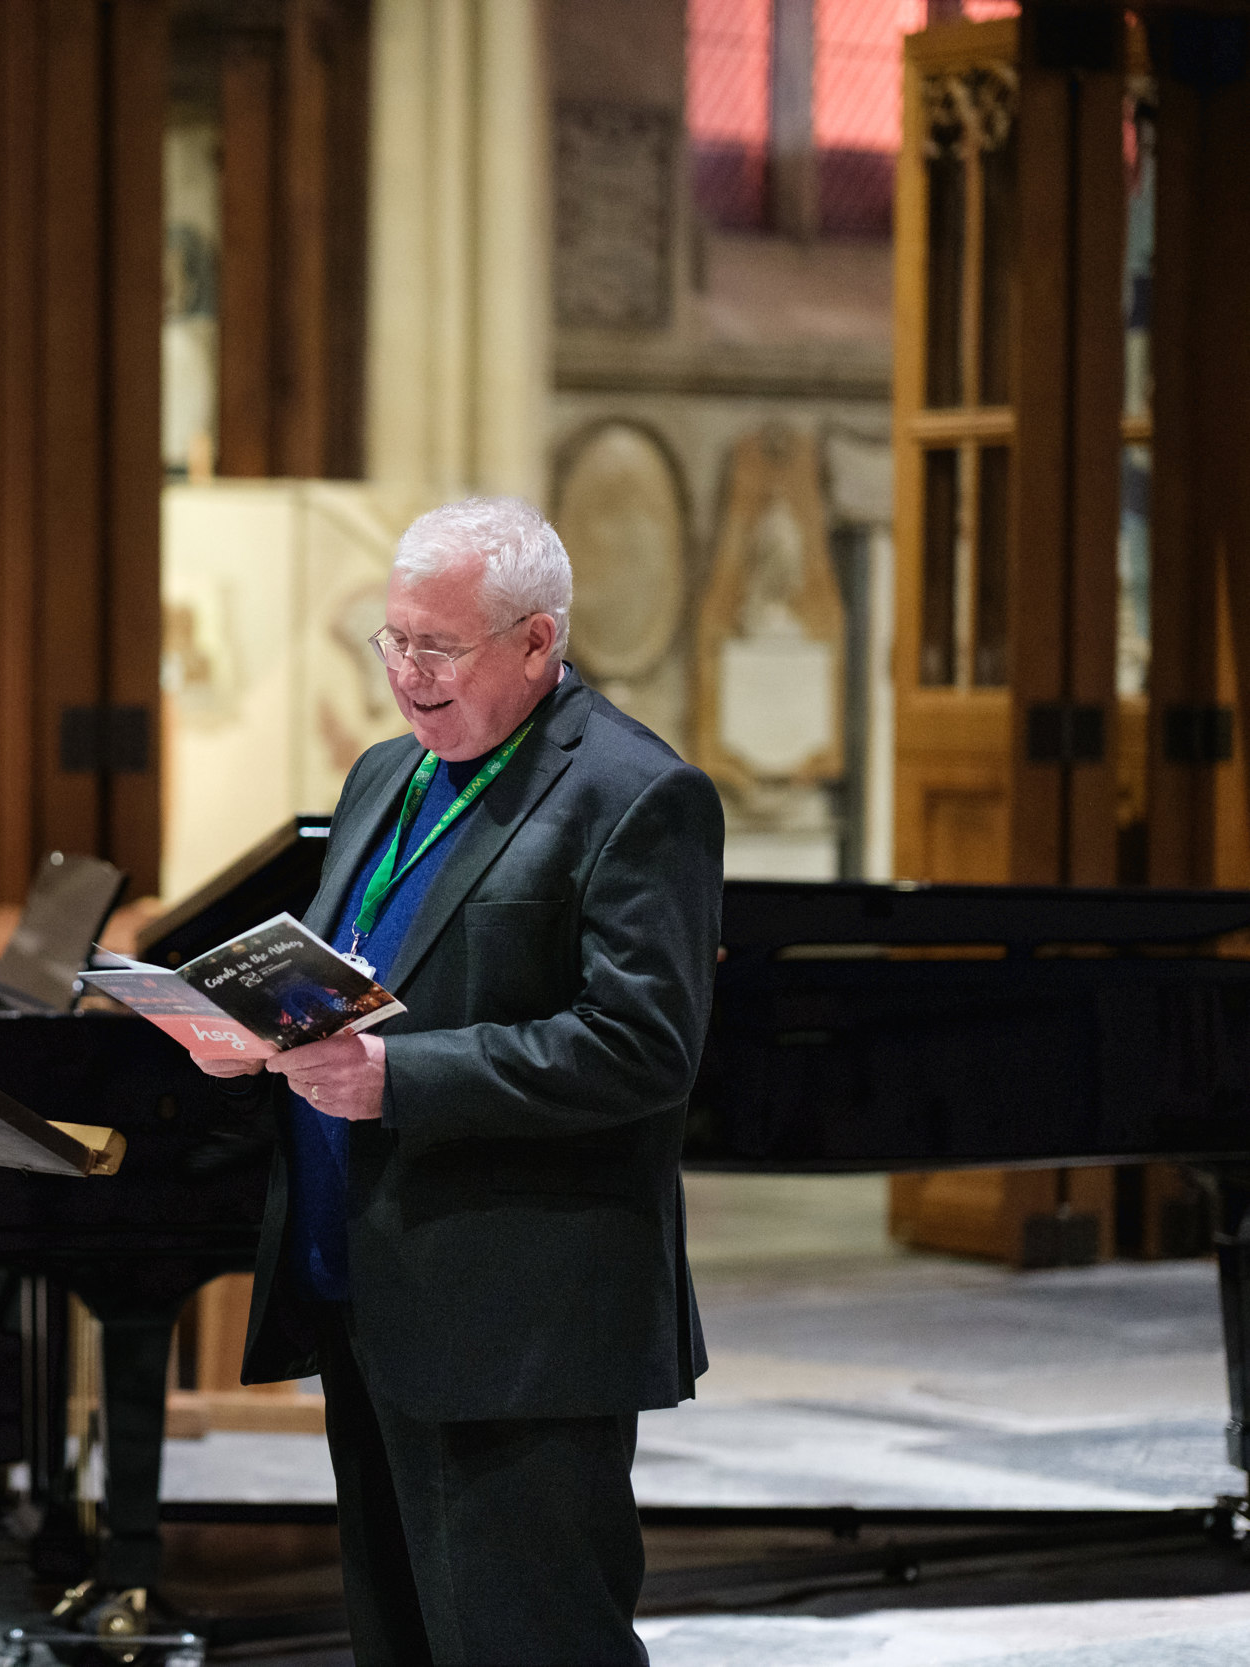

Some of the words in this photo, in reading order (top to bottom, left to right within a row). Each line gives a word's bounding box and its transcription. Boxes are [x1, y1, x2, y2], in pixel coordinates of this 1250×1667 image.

[442, 777, 486, 821] Wiltshire
[204, 967, 237, 988] Carols
[236, 961, 253, 971] in
[249, 952, 268, 964] the
[268, 940, 304, 956] Abbey
[189, 1022, 248, 1051] hsg
